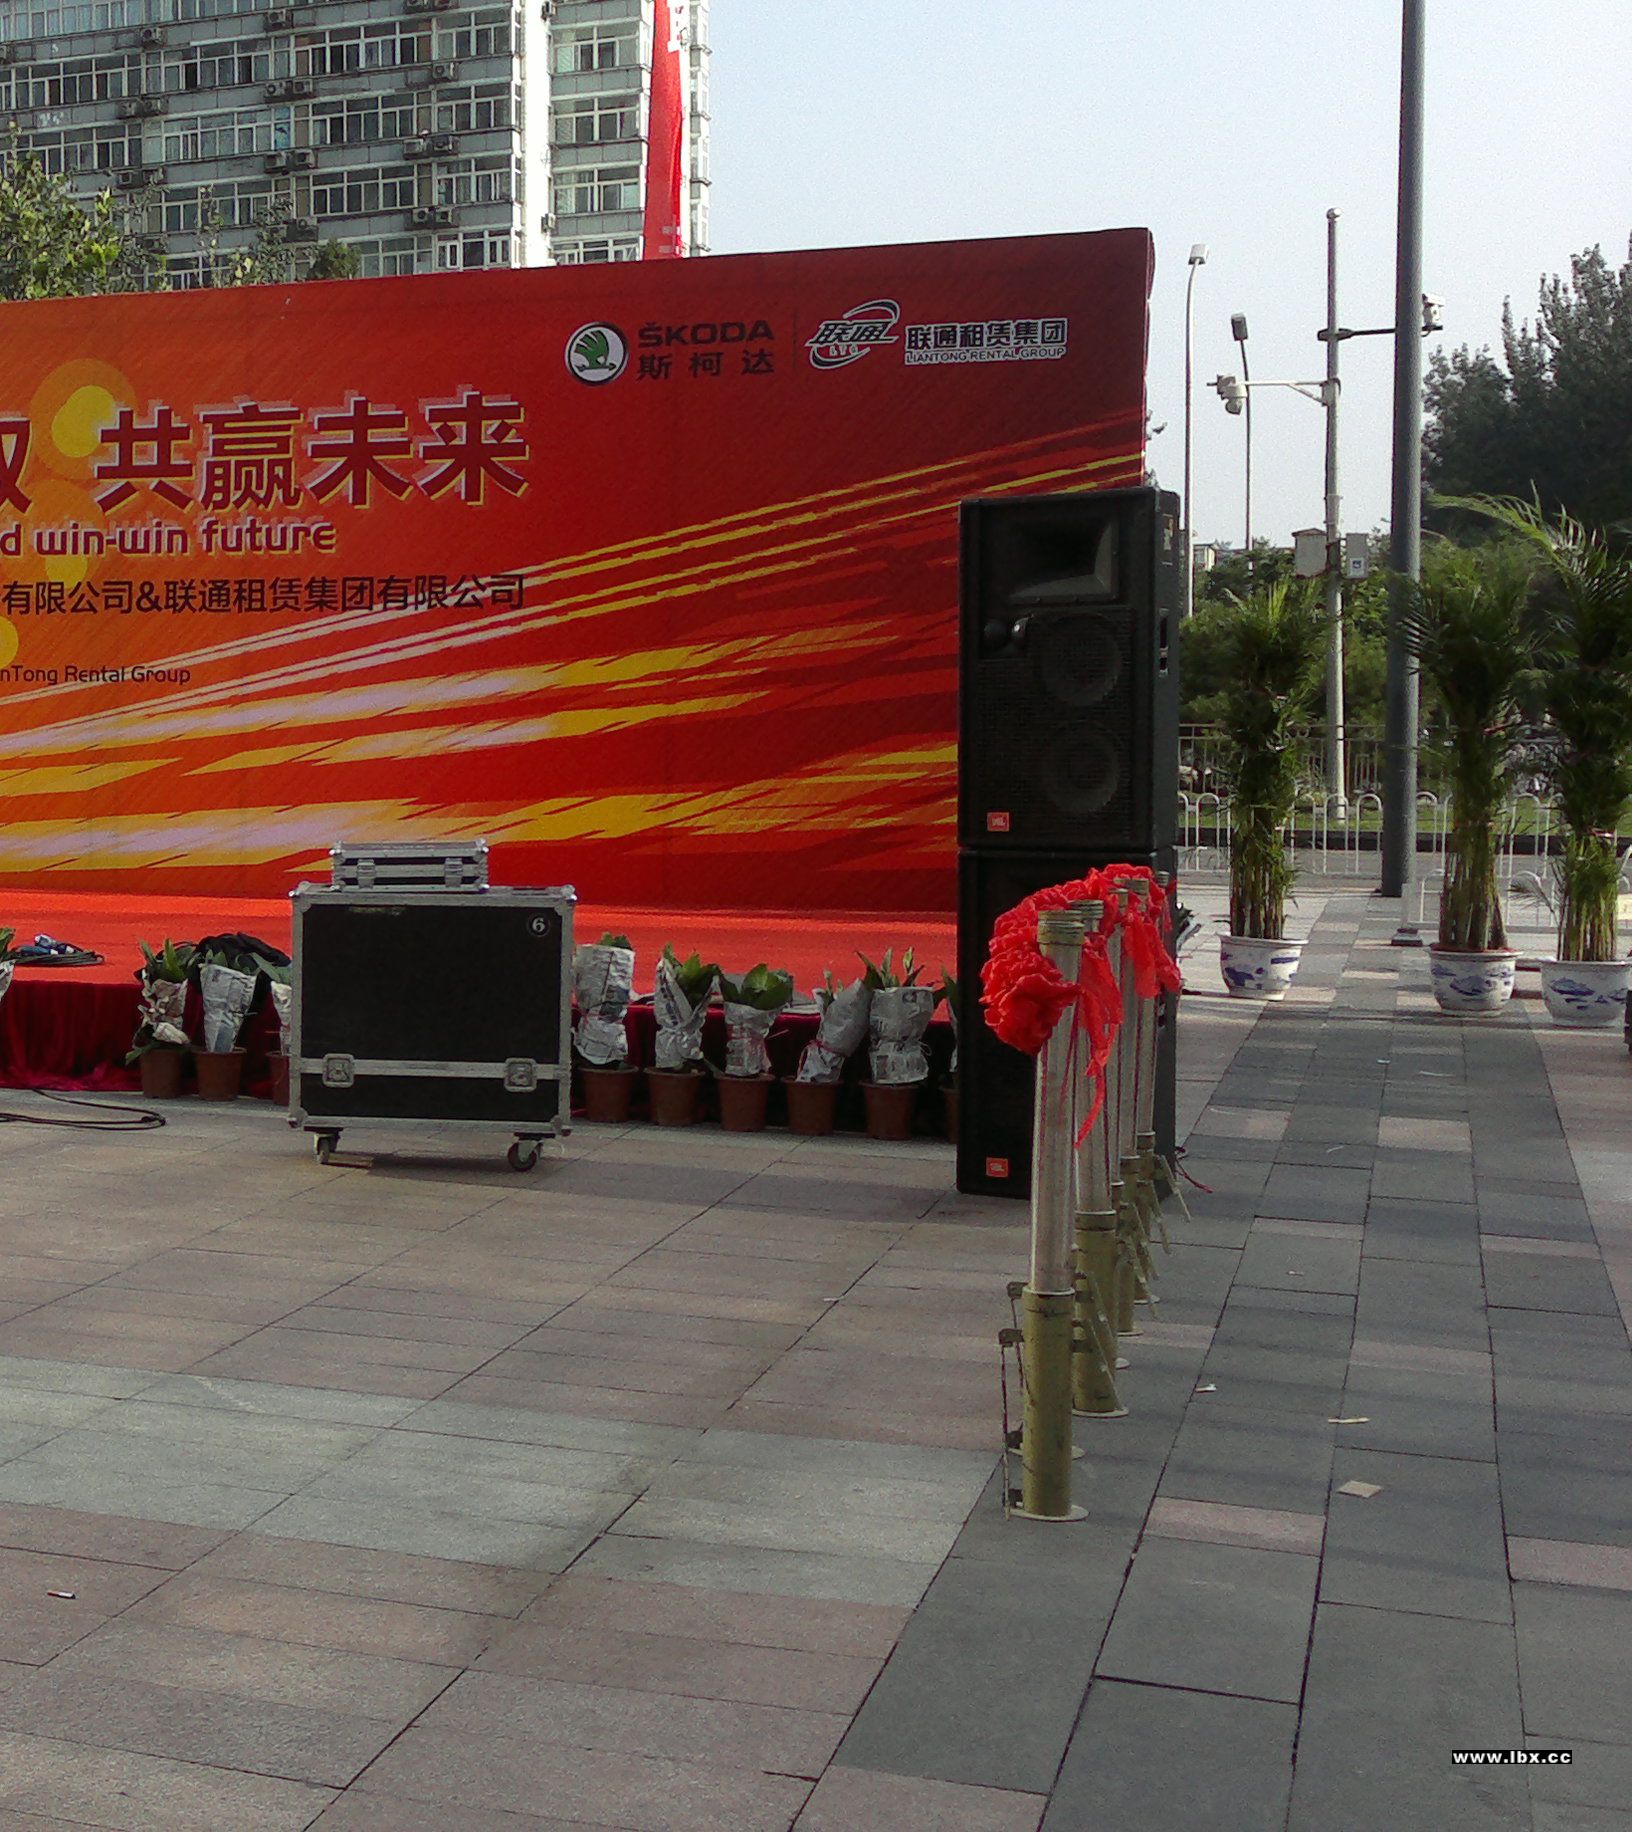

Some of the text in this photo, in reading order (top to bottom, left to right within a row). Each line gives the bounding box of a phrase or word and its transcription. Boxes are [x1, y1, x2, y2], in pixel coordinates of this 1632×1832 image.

[906, 319, 1067, 350] 联通租赁集团
[636, 348, 775, 381] 斯柯达
[906, 347, 1066, 363] LIANTONG RENTAL GROUP
[92, 388, 531, 515] 共赢未来
[34, 517, 192, 558] win-win
[200, 515, 338, 556] future
[64, 664, 125, 684] Rental
[131, 665, 191, 686] Group
[532, 917, 545, 932] 6
